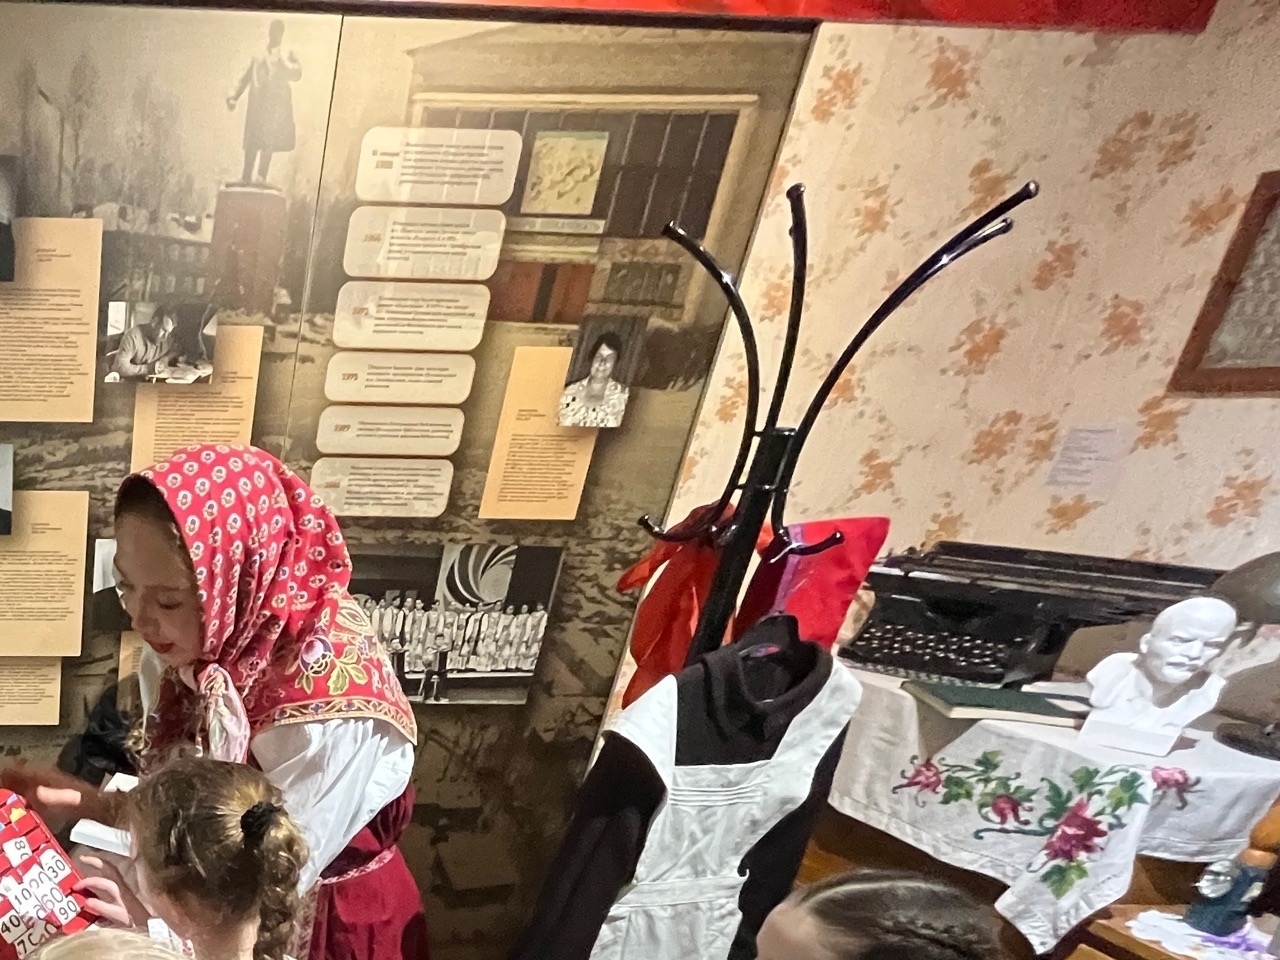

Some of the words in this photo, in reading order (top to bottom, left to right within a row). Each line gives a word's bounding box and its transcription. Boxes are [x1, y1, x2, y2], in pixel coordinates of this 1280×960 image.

[47, 859, 66, 879] 30
[14, 888, 32, 906] 10
[41, 887, 64, 911] 60
[59, 900, 78, 920] 90
[1, 914, 21, 934] 40
